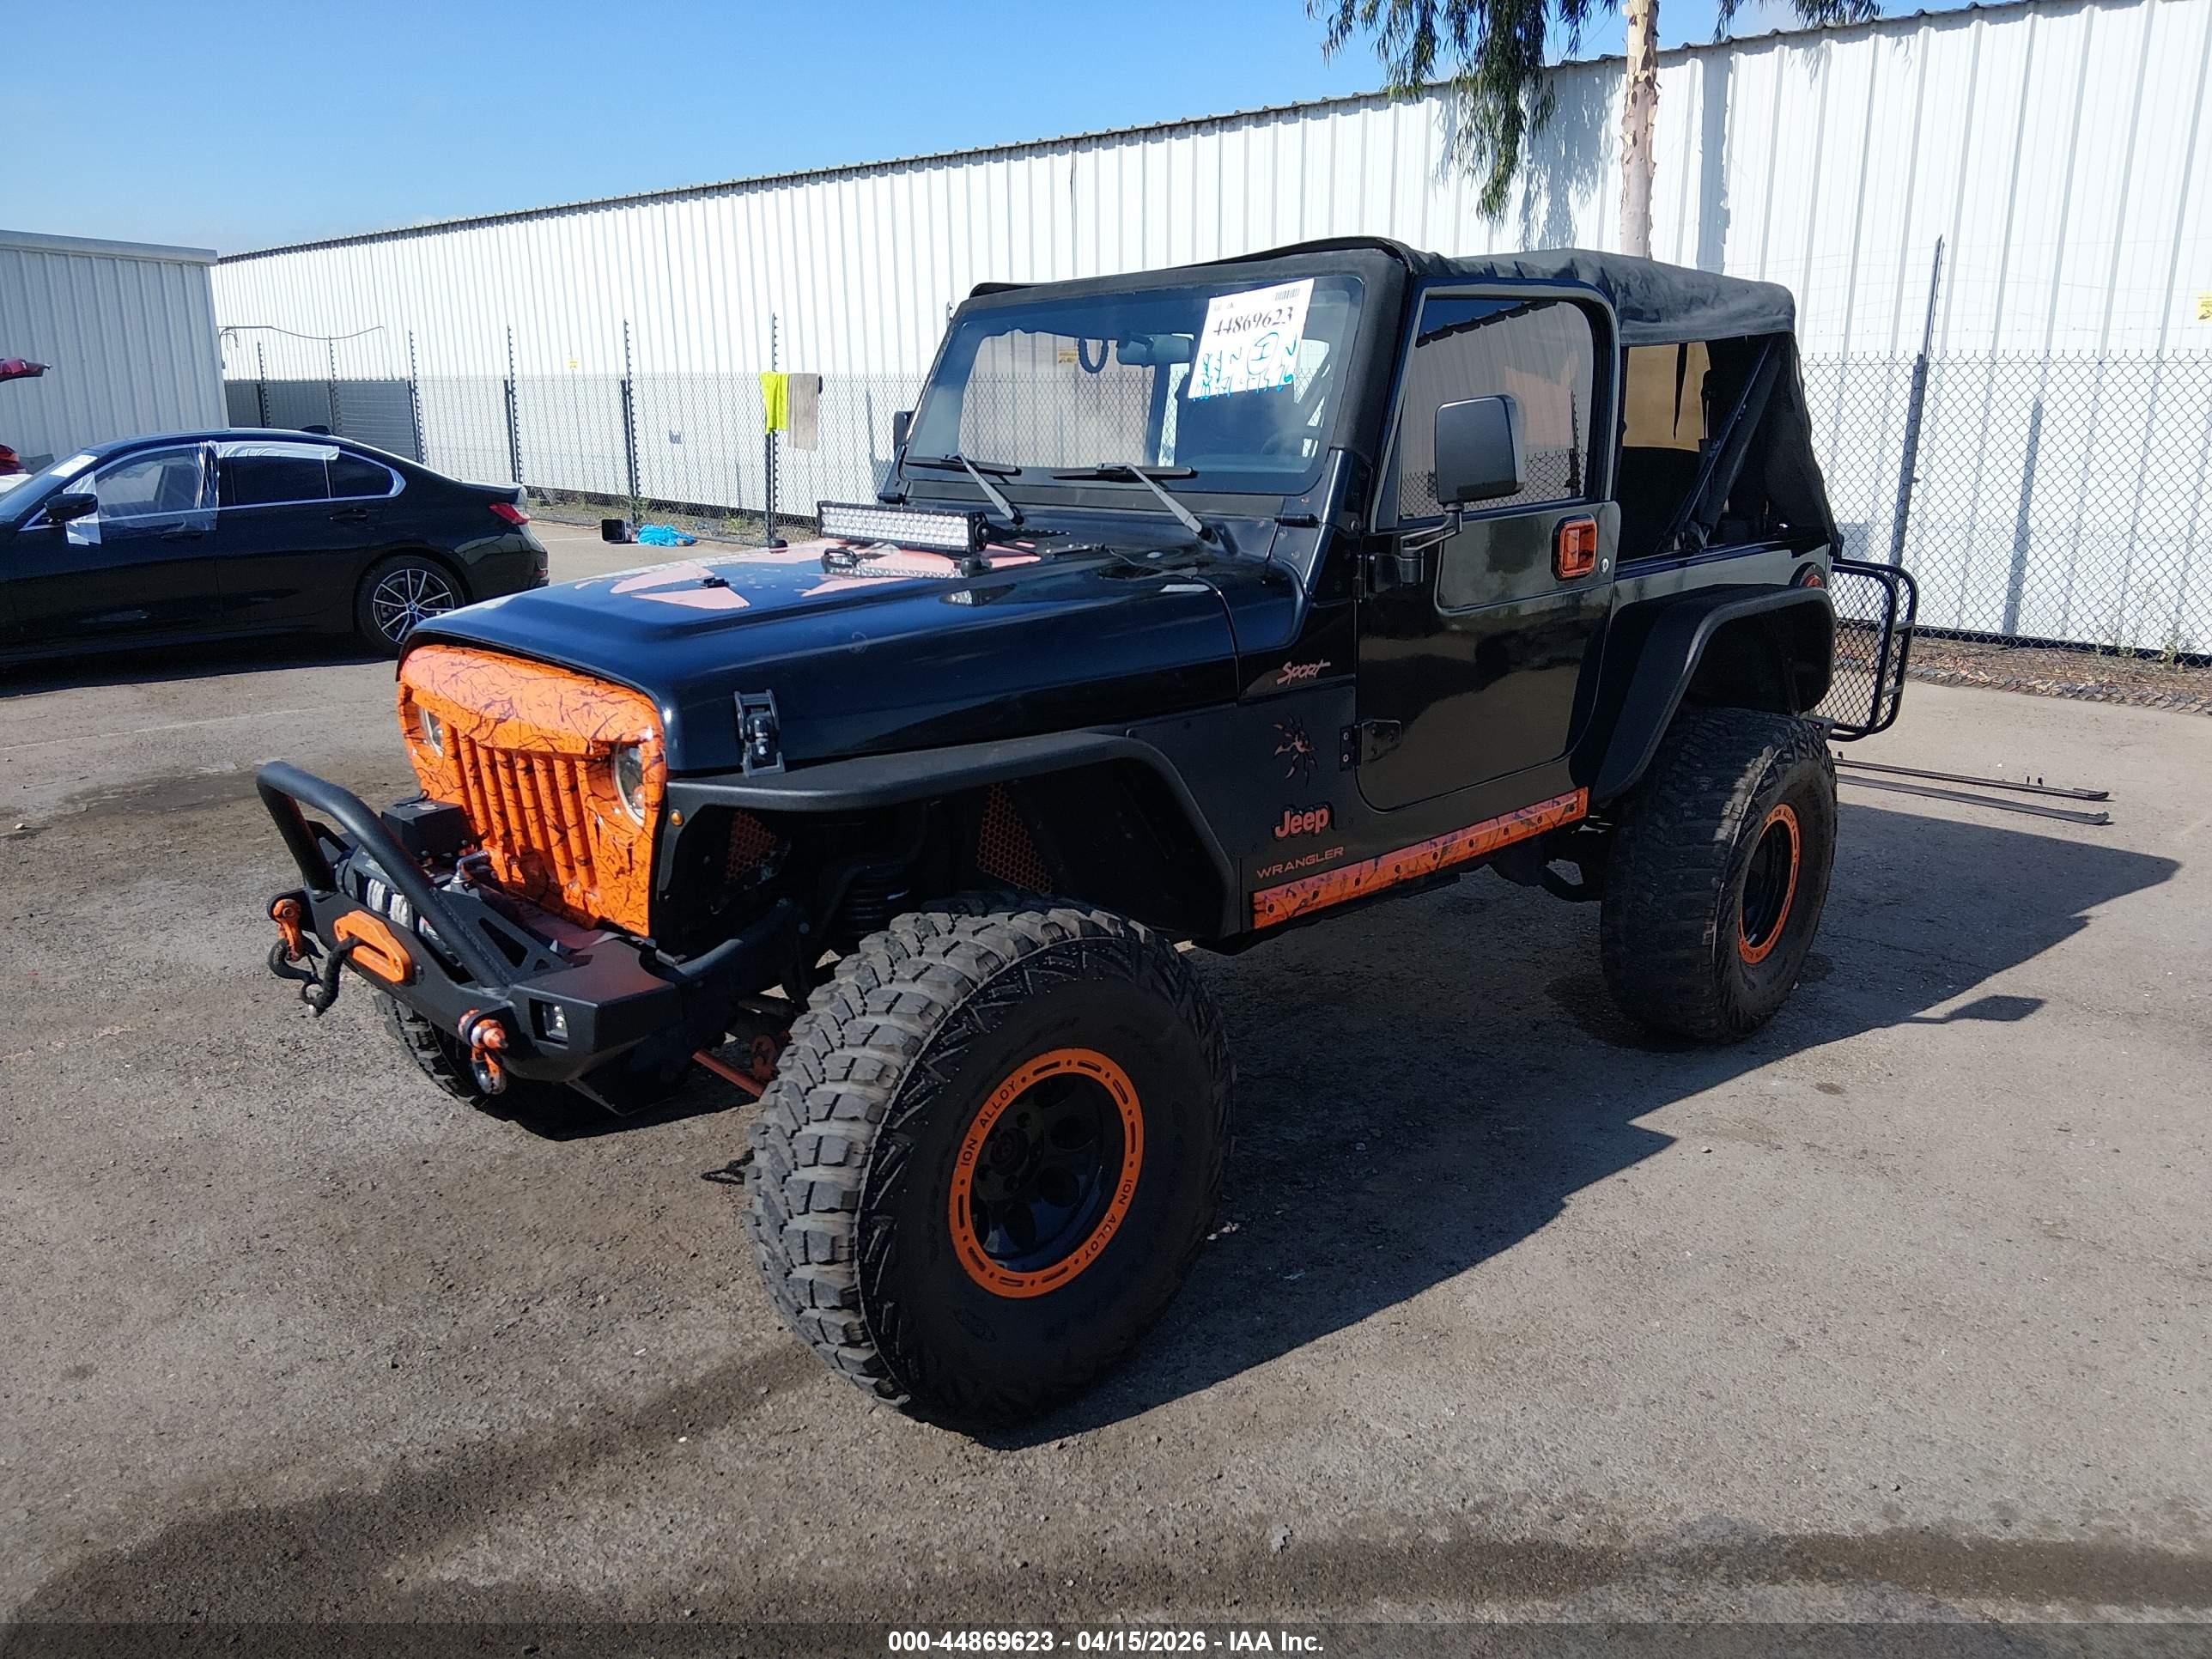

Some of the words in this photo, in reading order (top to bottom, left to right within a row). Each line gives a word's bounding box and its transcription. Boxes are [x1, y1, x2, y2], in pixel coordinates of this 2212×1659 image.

[1213, 307, 1294, 336] 44869623
[1277, 659, 1331, 686] Sport
[1274, 807, 1330, 839] Jeep
[1256, 846, 1345, 879] WRANGLER
[960, 1138, 978, 1166] ION
[979, 1080, 1018, 1129] ALLOY
[1117, 1179, 1133, 1205] ION
[1084, 1213, 1117, 1261] ALLOY
